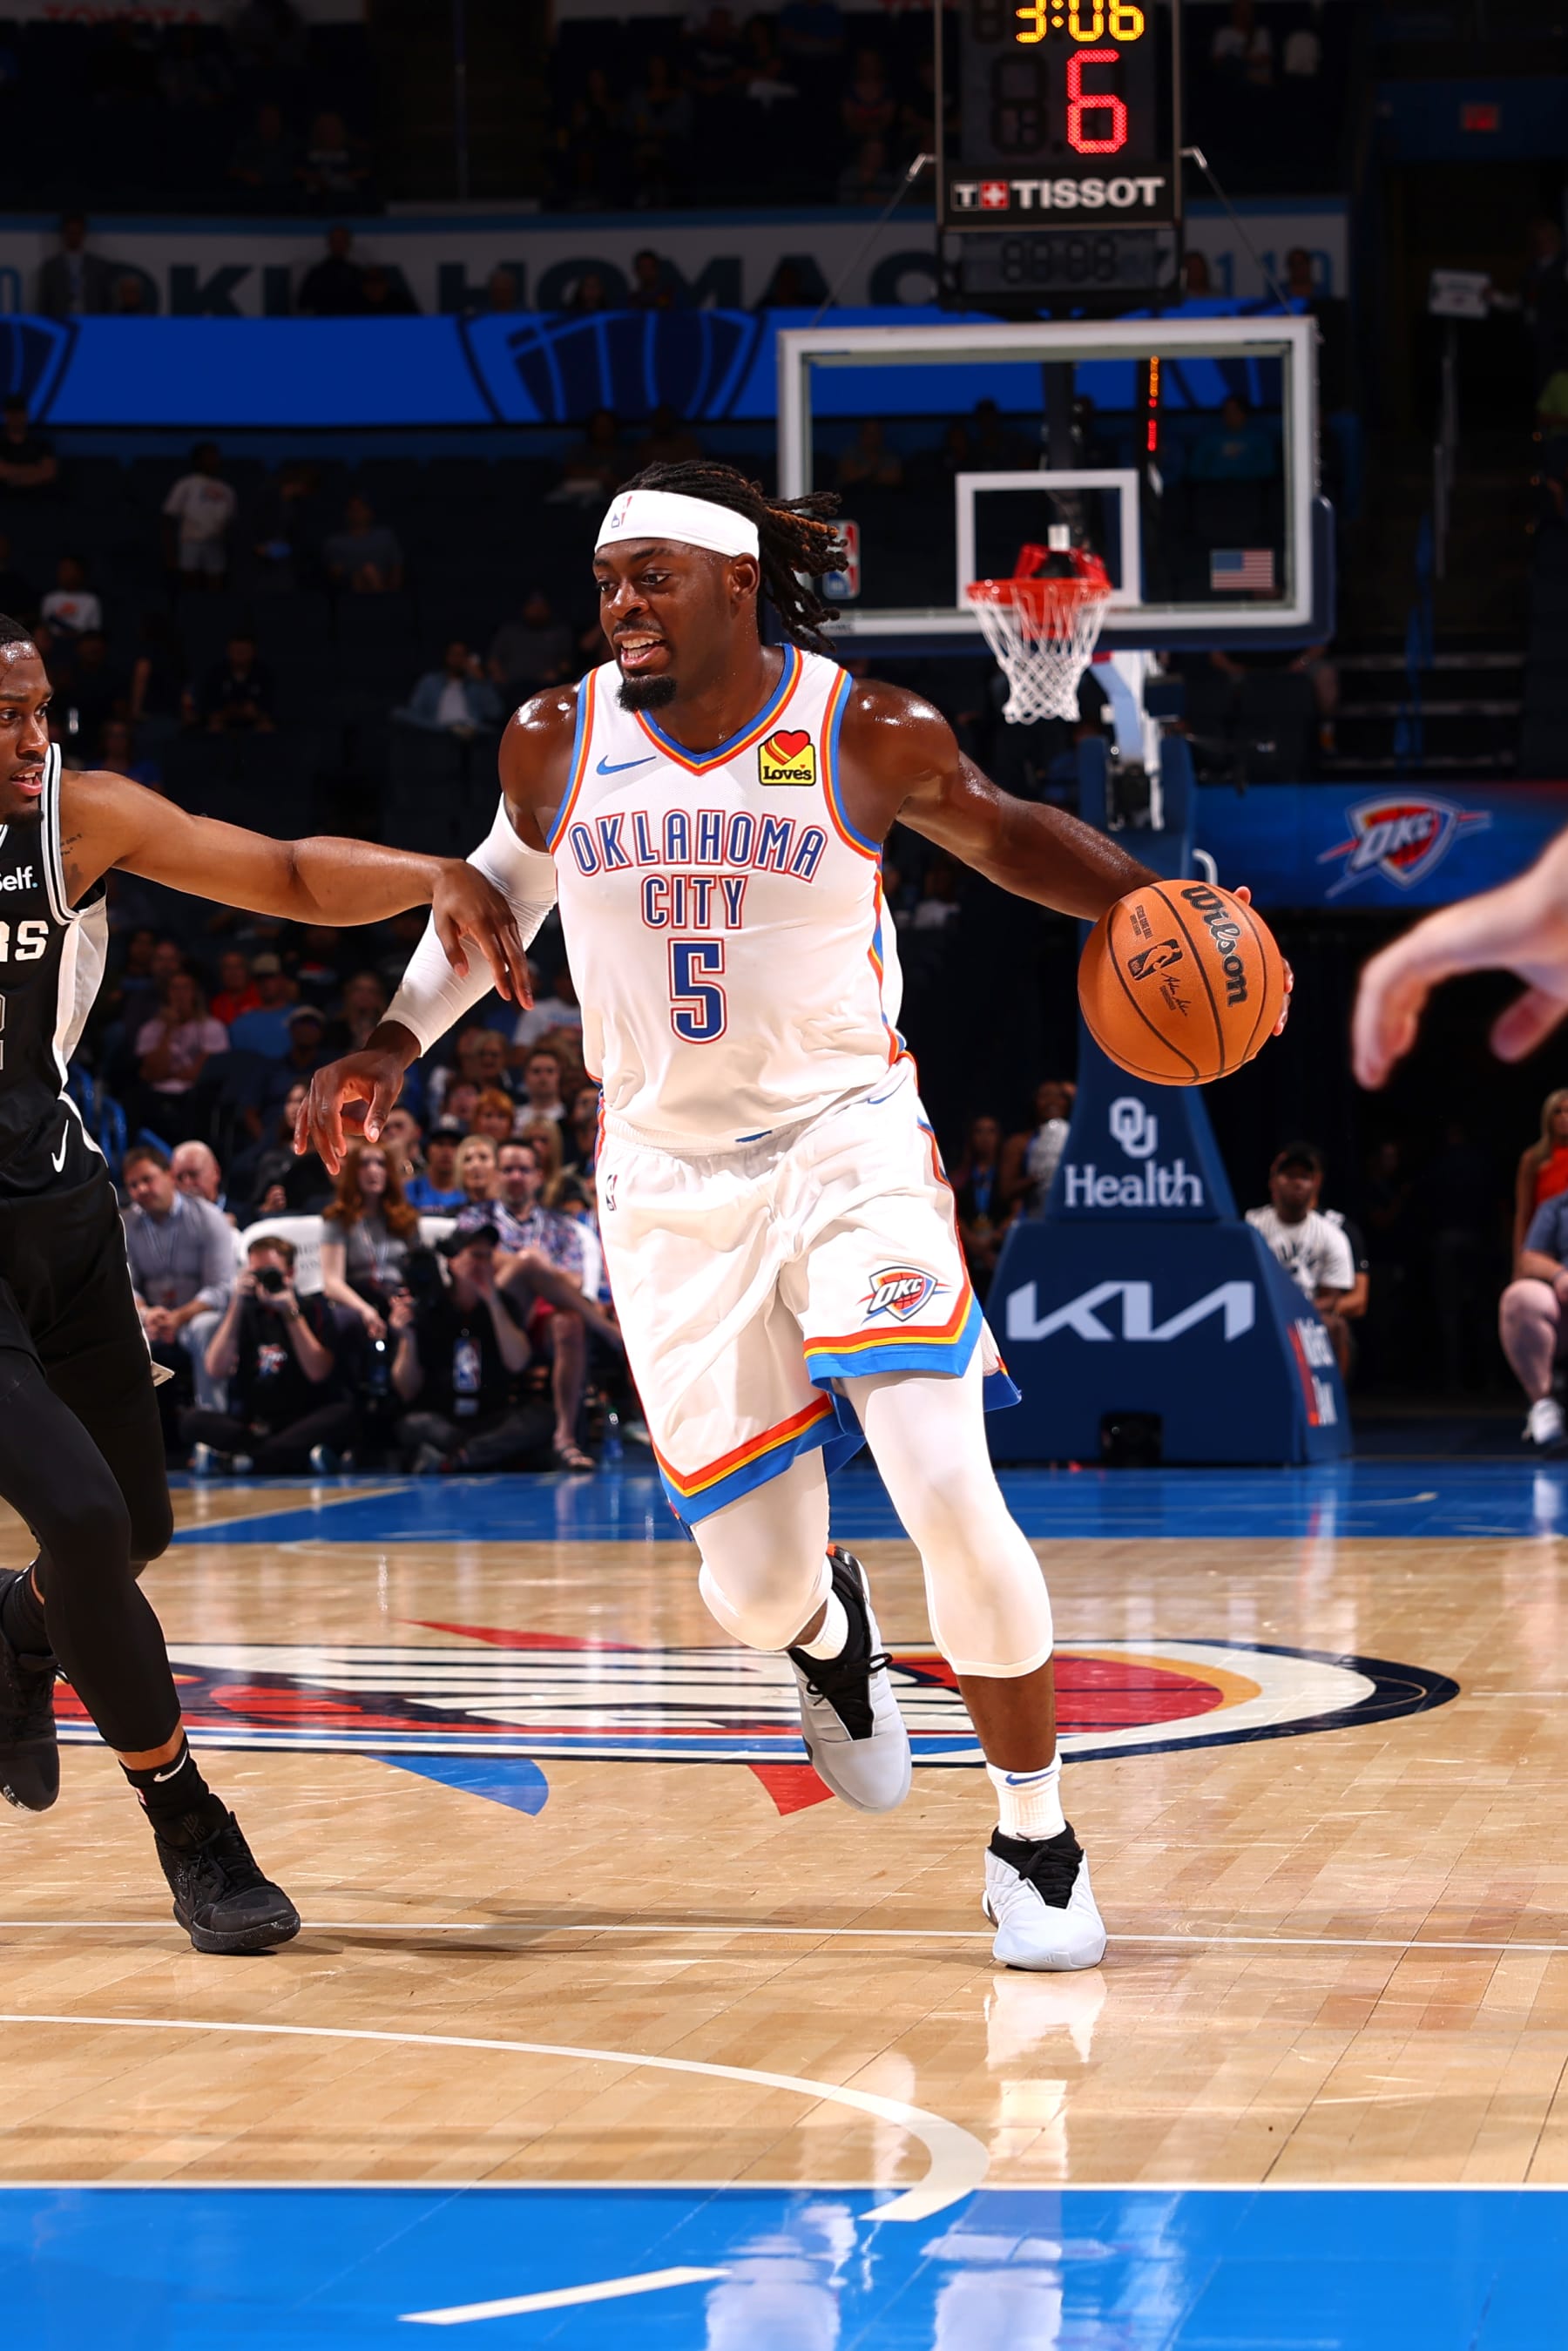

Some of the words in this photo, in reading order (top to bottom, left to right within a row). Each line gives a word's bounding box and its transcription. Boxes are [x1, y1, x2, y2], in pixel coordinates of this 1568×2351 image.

[1015, 0, 1146, 44] 3:06
[1065, 48, 1128, 155] 6
[1009, 176, 1166, 209] TISSOT
[568, 808, 828, 883] OKLAHOMA
[0, 865, 38, 892] elf.
[640, 873, 747, 929] CITY
[1180, 884, 1249, 1008] Wilson
[667, 936, 727, 1045] 5
[1064, 1159, 1205, 1208] Health
[868, 1277, 923, 1314] OKC
